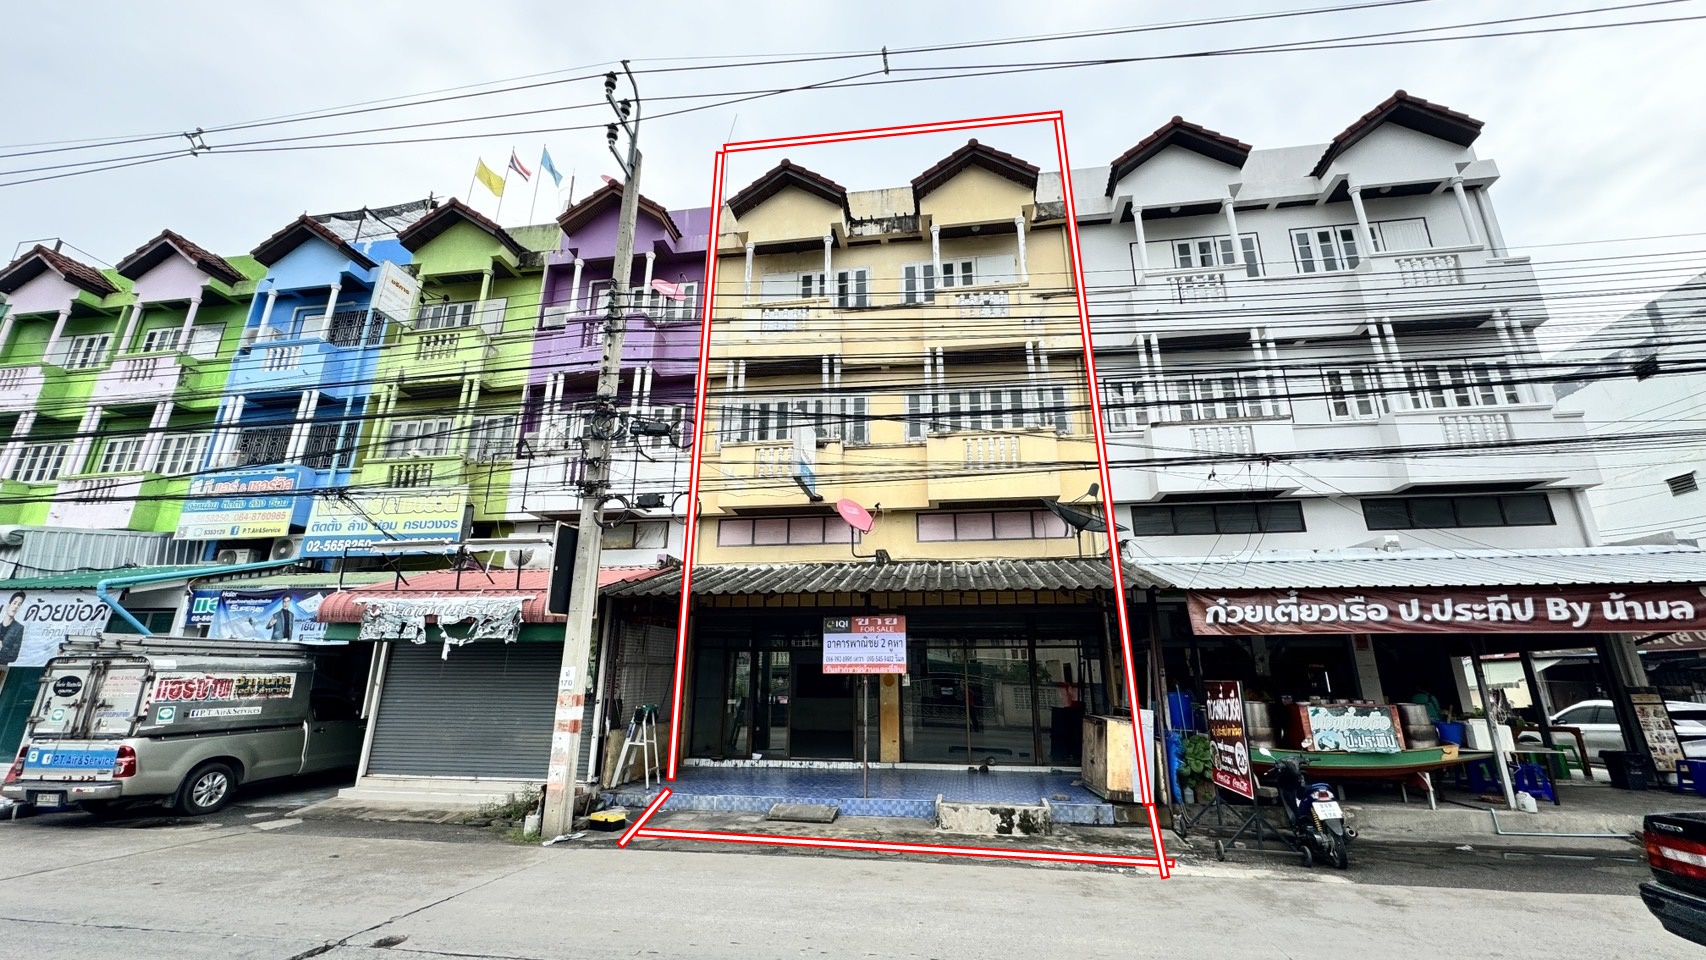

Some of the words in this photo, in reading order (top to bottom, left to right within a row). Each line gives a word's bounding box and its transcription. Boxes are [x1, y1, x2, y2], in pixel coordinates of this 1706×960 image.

[311, 518, 342, 532] ติดตั้ง
[347, 520, 368, 531] ล้าง
[403, 519, 459, 530] ครบวงจร
[1205, 590, 1390, 624] ก๋วยเตี๋ยวเรือ
[1398, 594, 1534, 622] ป.ประทีป
[1546, 597, 1591, 628] By
[1601, 592, 1695, 621] น้ามล
[836, 620, 849, 628] IQI
[855, 617, 898, 626] ขาย
[827, 635, 879, 648] อาคารพาณิชย์
[881, 638, 886, 648] 2
[888, 639, 904, 652] คูหา
